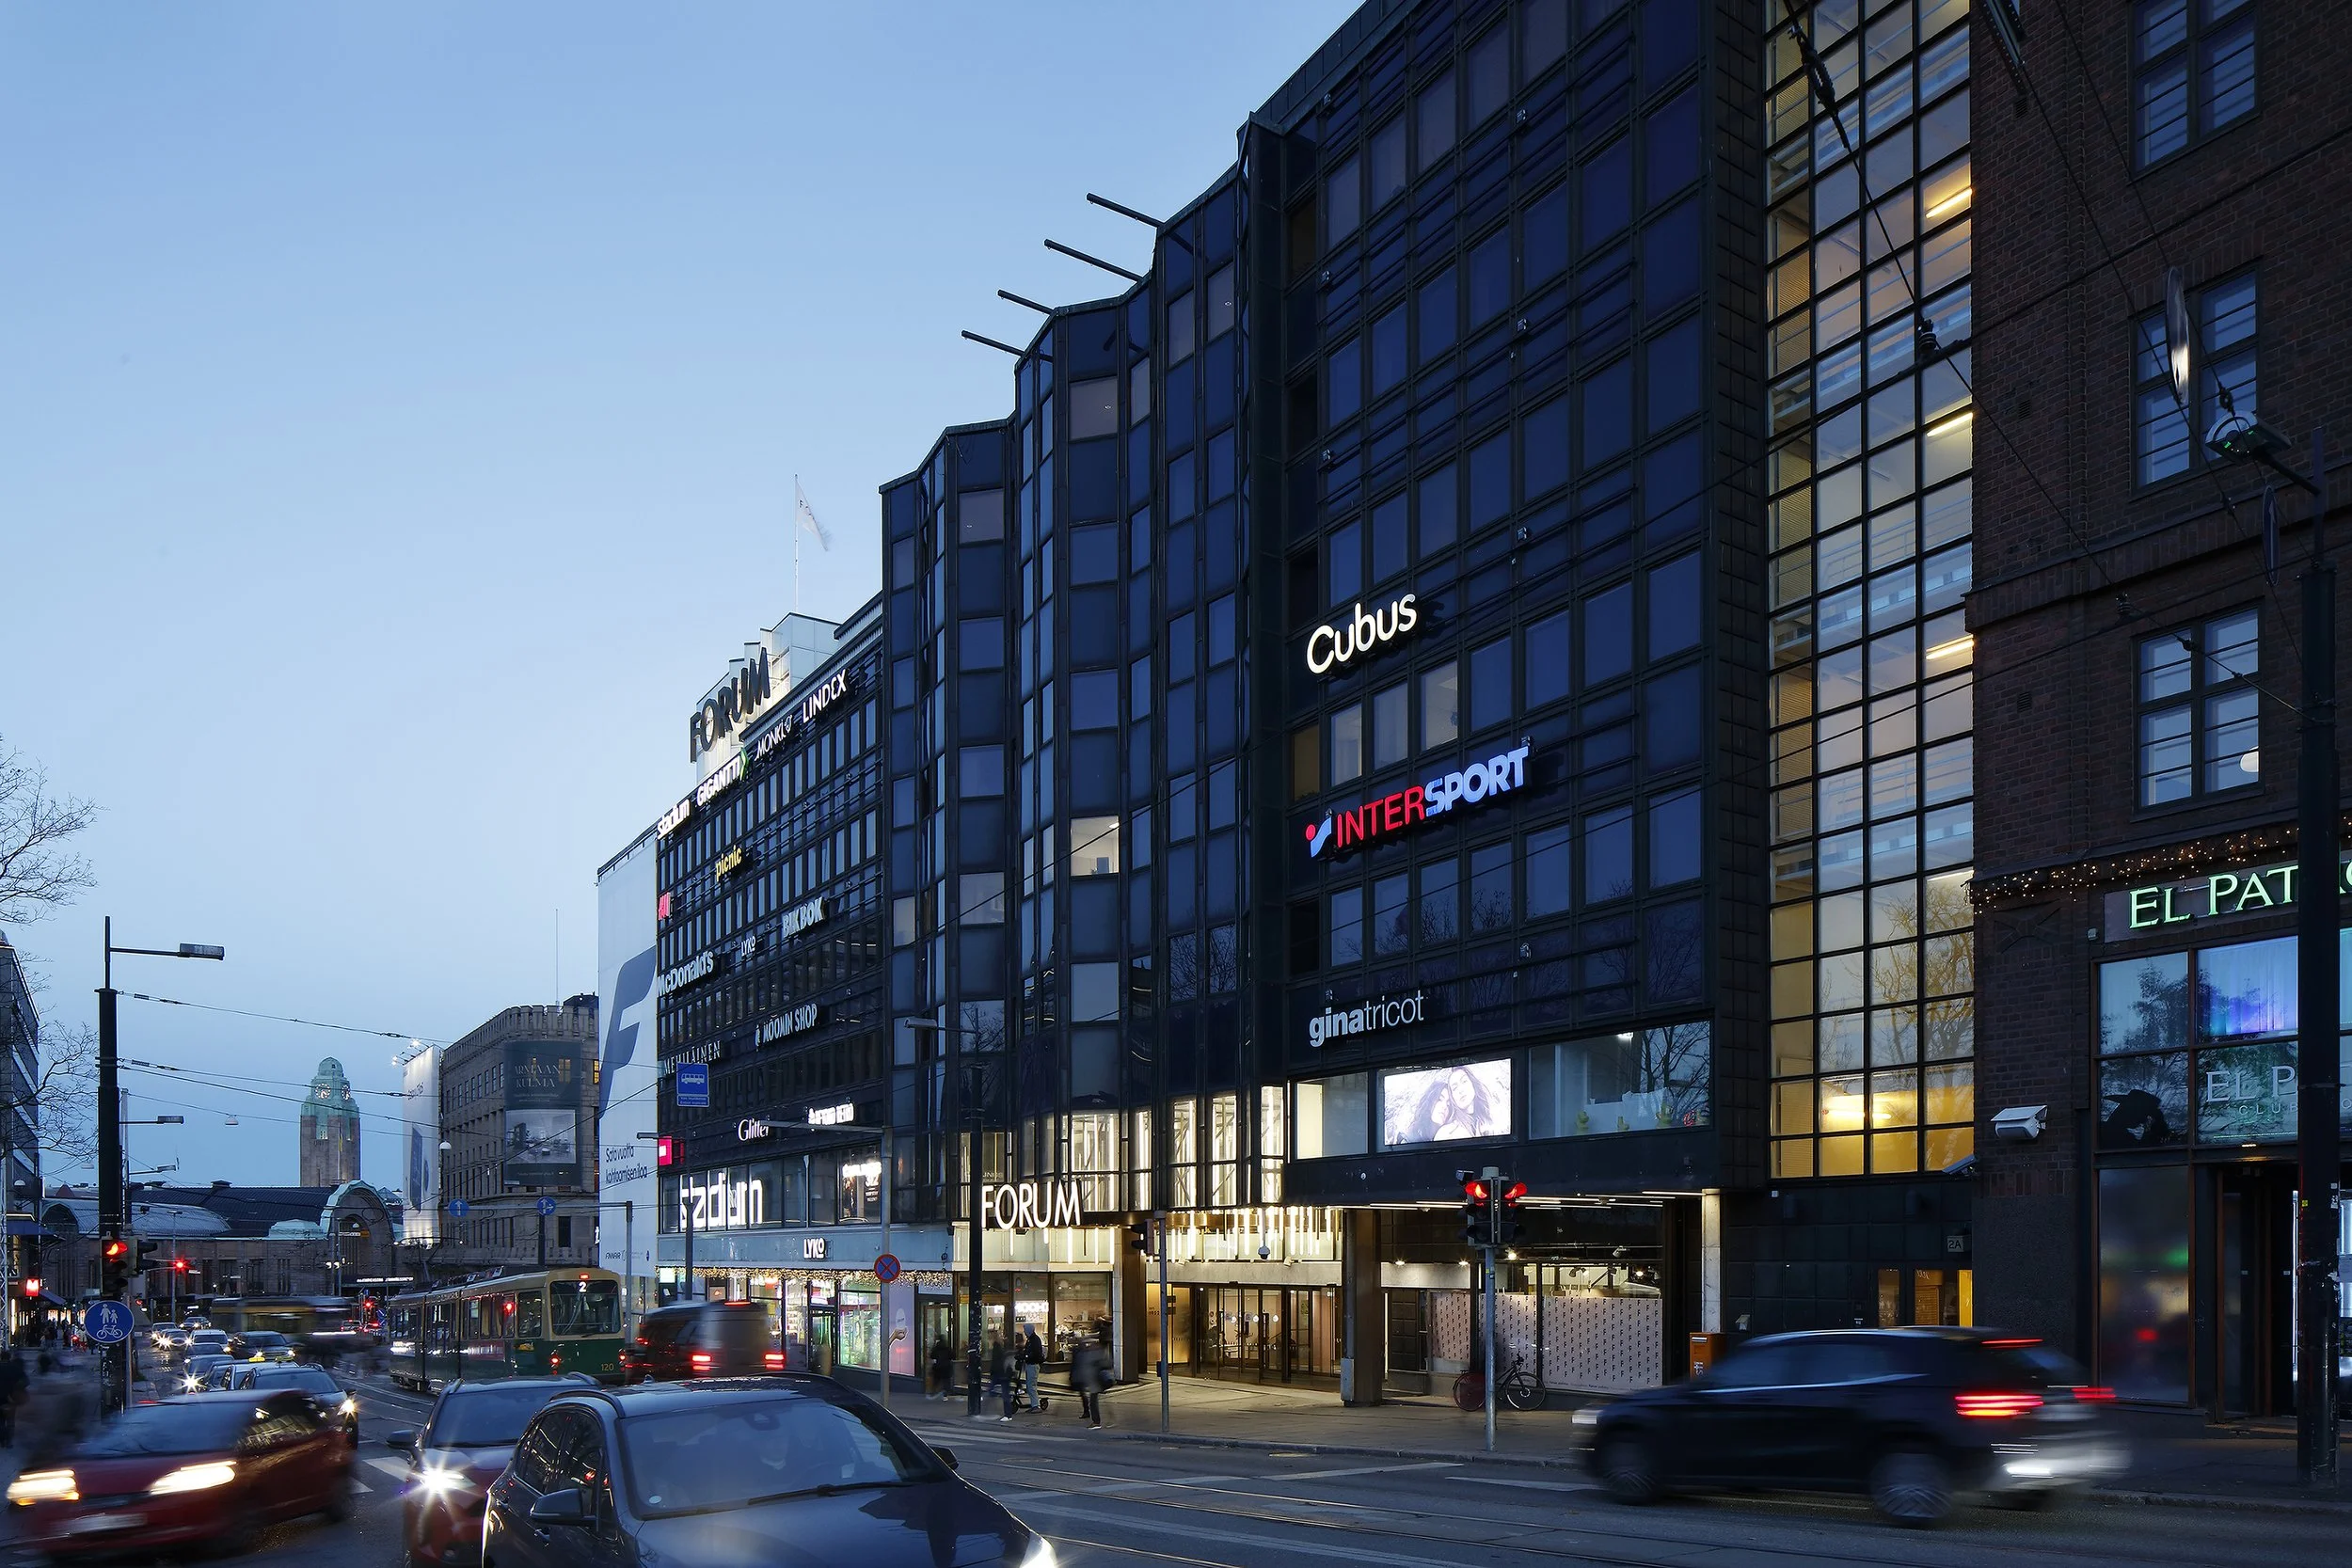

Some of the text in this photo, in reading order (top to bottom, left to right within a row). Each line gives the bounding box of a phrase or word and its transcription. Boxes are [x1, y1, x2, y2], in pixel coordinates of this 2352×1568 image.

[1306, 594, 1418, 674] Cubus
[690, 646, 771, 763] FORUM
[803, 668, 847, 723] LINDEX
[696, 755, 740, 806] GIGANTTI
[1336, 746, 1529, 847] INTERSPORT
[715, 845, 742, 881] picnic
[2129, 885, 2190, 929] EL
[658, 951, 714, 997] McDonald's
[794, 1003, 818, 1032] SHOP
[2205, 1070, 2257, 1102] EL
[738, 1118, 770, 1141] Glitter
[981, 1180, 1081, 1229] FORUM
[803, 1238, 825, 1259] LYKO
[579, 1282, 587, 1292] 2
[601, 1363, 614, 1371] 120
